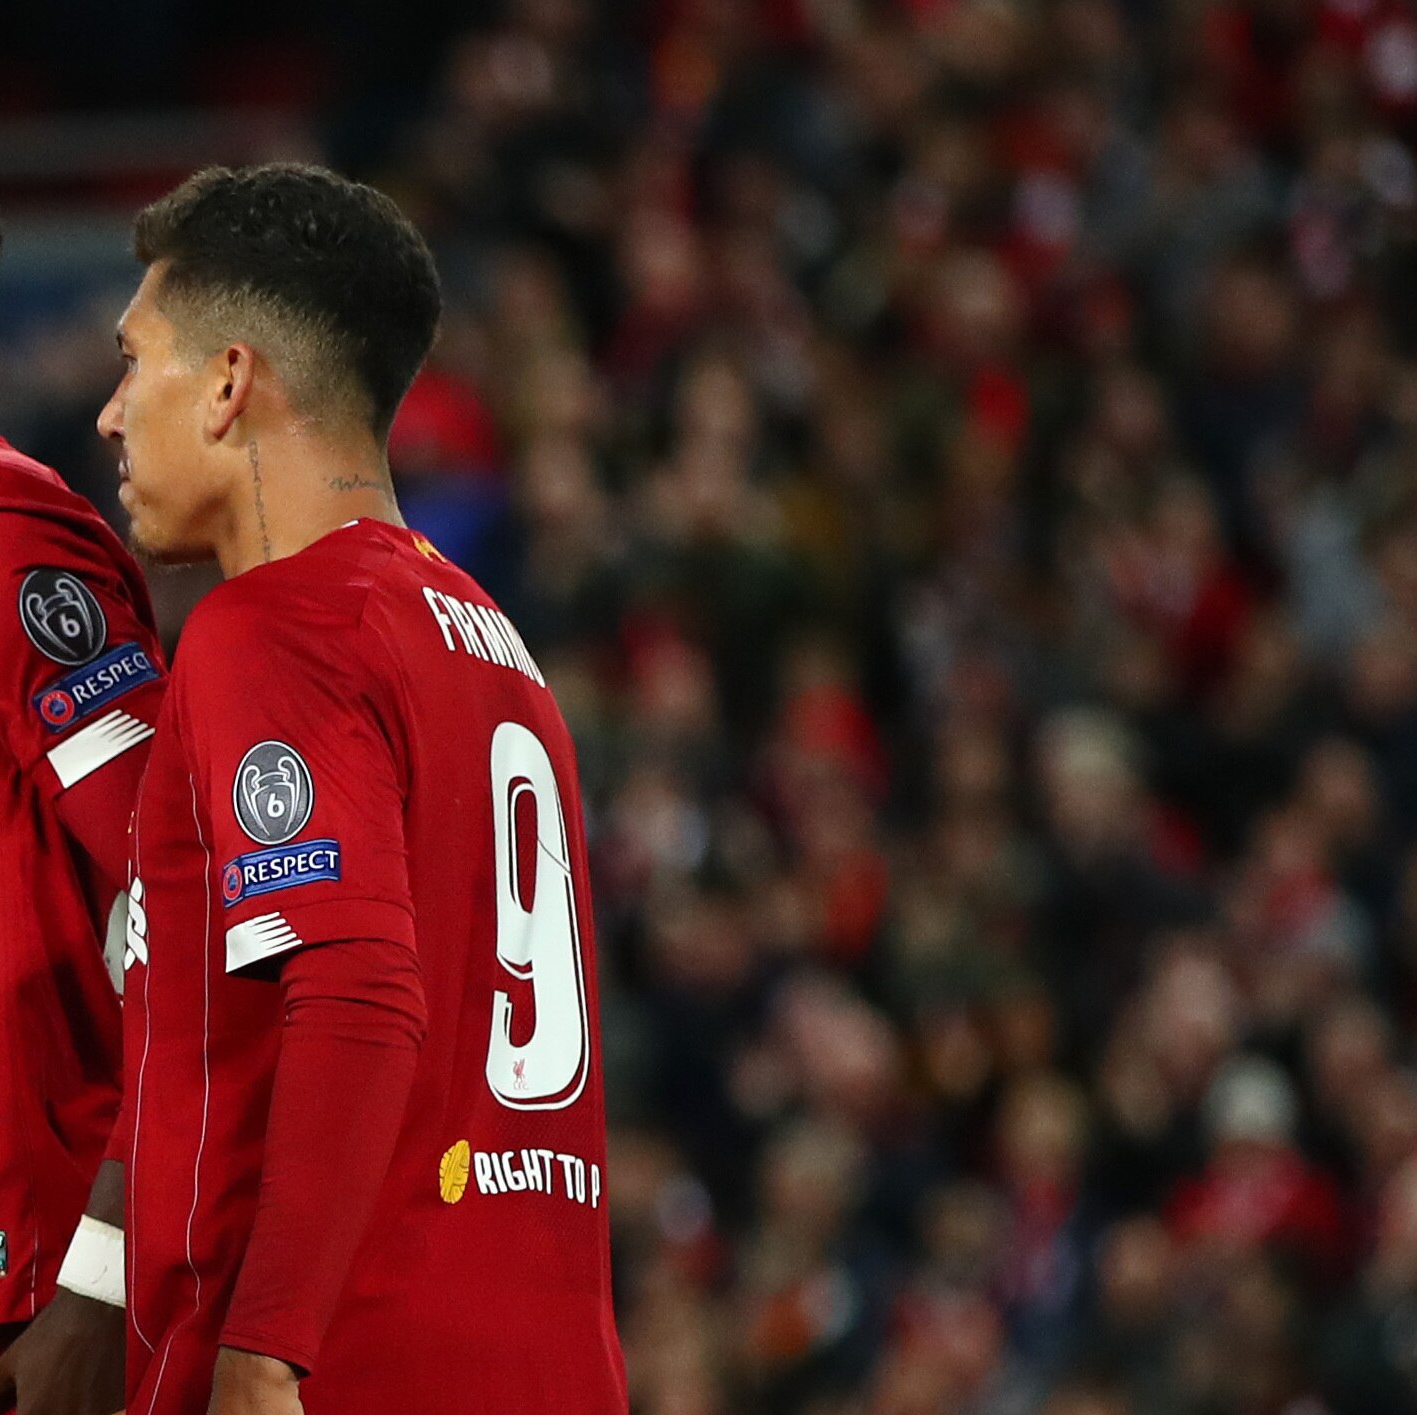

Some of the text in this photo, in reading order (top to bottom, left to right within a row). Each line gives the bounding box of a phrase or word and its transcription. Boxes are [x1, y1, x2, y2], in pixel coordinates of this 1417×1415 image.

[267, 793, 285, 818] 6
[243, 850, 339, 885] RESPECT
[485, 721, 590, 1111] 9
[473, 1148, 555, 1195] RIGHT
[556, 1153, 586, 1204] TO
